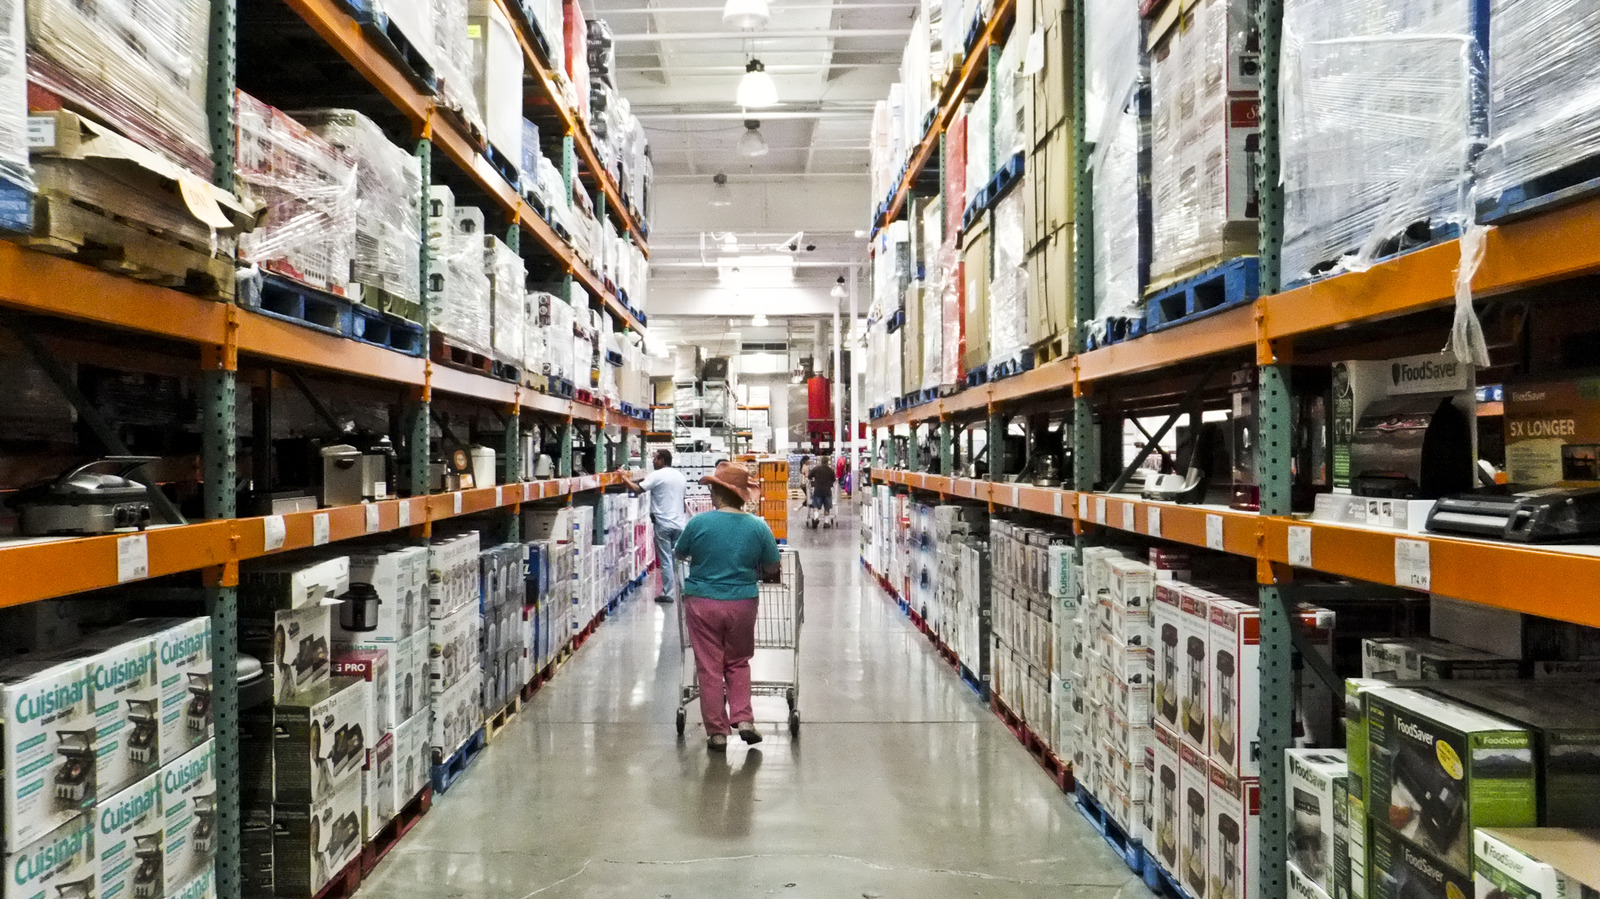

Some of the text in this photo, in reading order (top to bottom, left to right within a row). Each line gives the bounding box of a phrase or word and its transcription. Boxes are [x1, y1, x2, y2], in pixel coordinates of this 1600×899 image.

[1401, 361, 1458, 381] FoodSaver
[1526, 418, 1576, 436] LONGER
[1059, 552, 1068, 595] Cuisinart
[160, 629, 211, 665] Cuisinart
[95, 650, 157, 691] Cuisinart
[344, 663, 366, 672] PRO
[15, 673, 95, 724] Cuisinart
[1397, 717, 1434, 746] FoodSaver
[1483, 736, 1528, 745] FoodSaver
[164, 751, 214, 794] Cuisinart
[1295, 760, 1327, 792] FoodSaver
[100, 782, 163, 835] Cuisinart
[14, 822, 95, 886] Cuisinart
[1405, 848, 1443, 883] FoodSaver
[1489, 845, 1525, 874] FoodSaver
